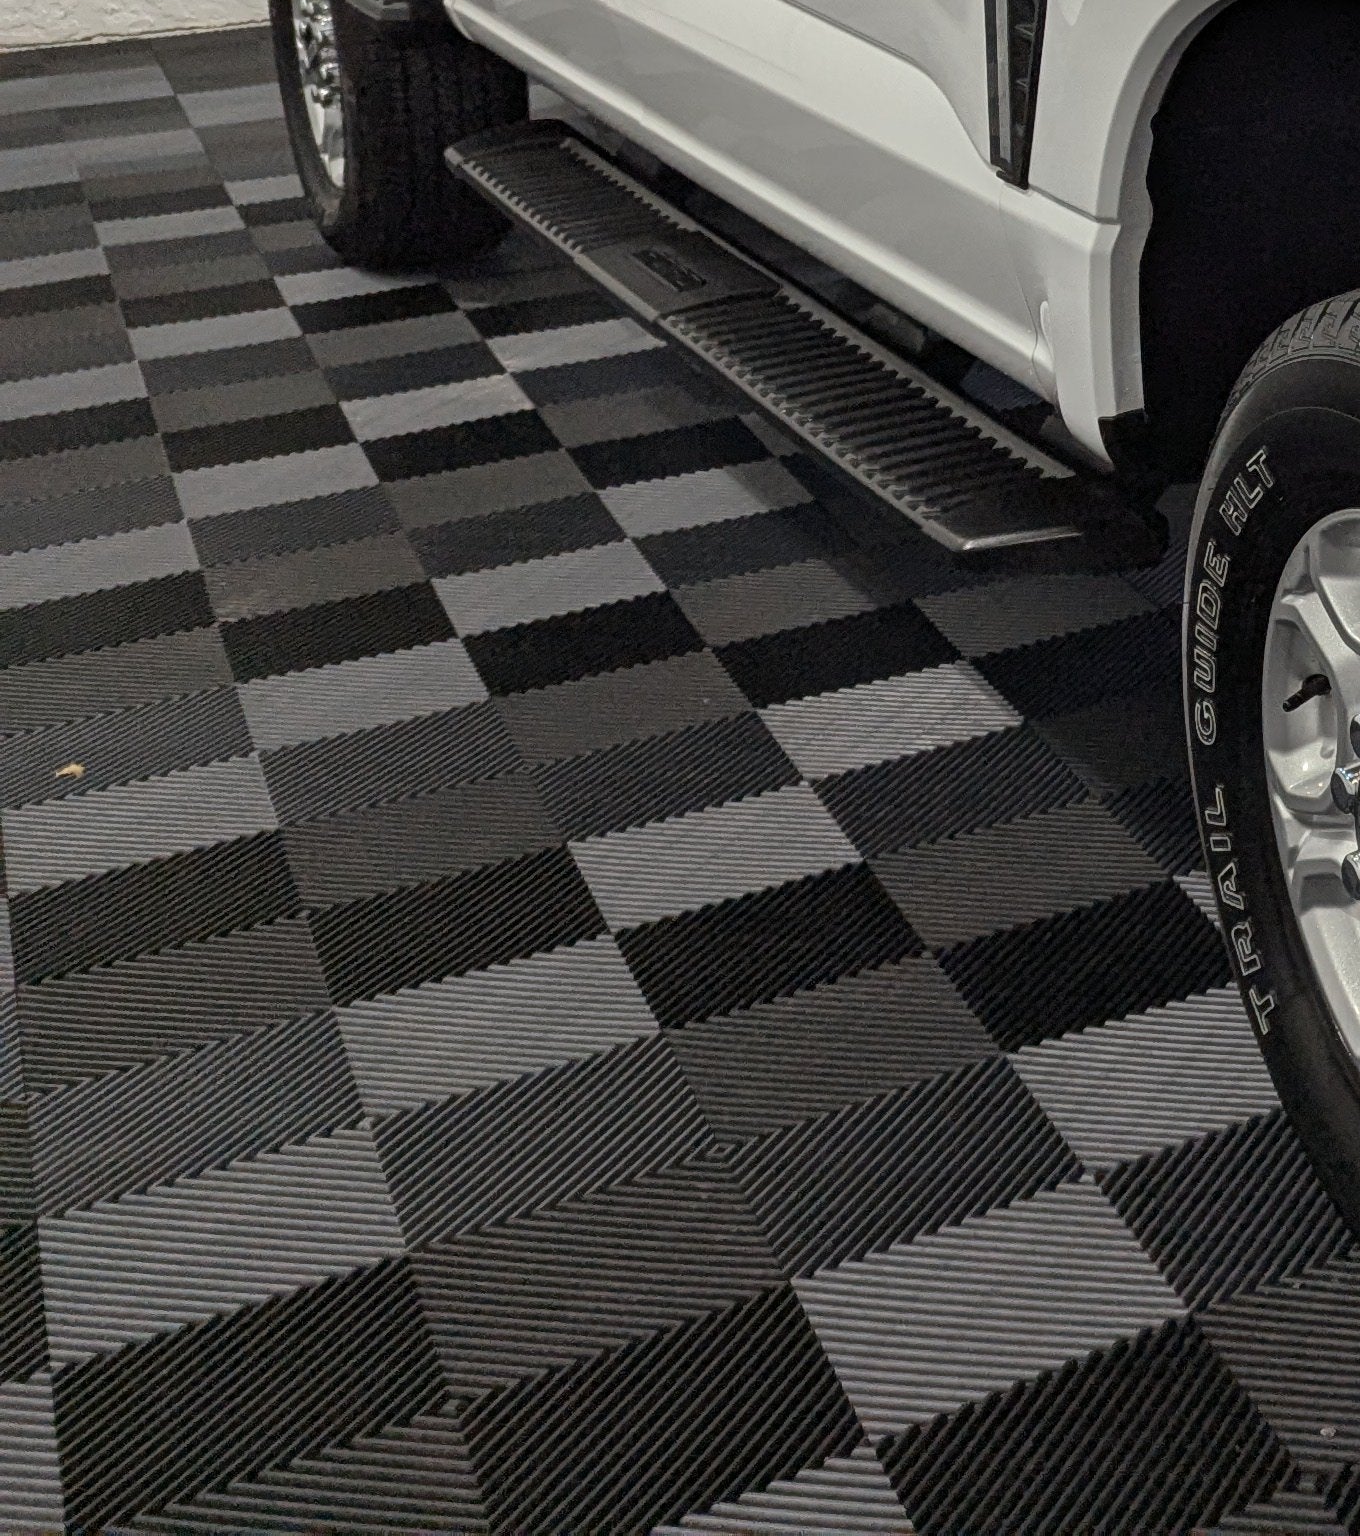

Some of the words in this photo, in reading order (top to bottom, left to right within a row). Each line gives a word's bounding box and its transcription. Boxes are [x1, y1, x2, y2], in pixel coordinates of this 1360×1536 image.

[1219, 447, 1273, 536] HLT
[1194, 538, 1230, 746] GUIDE
[1204, 784, 1275, 1035] TRAIL
